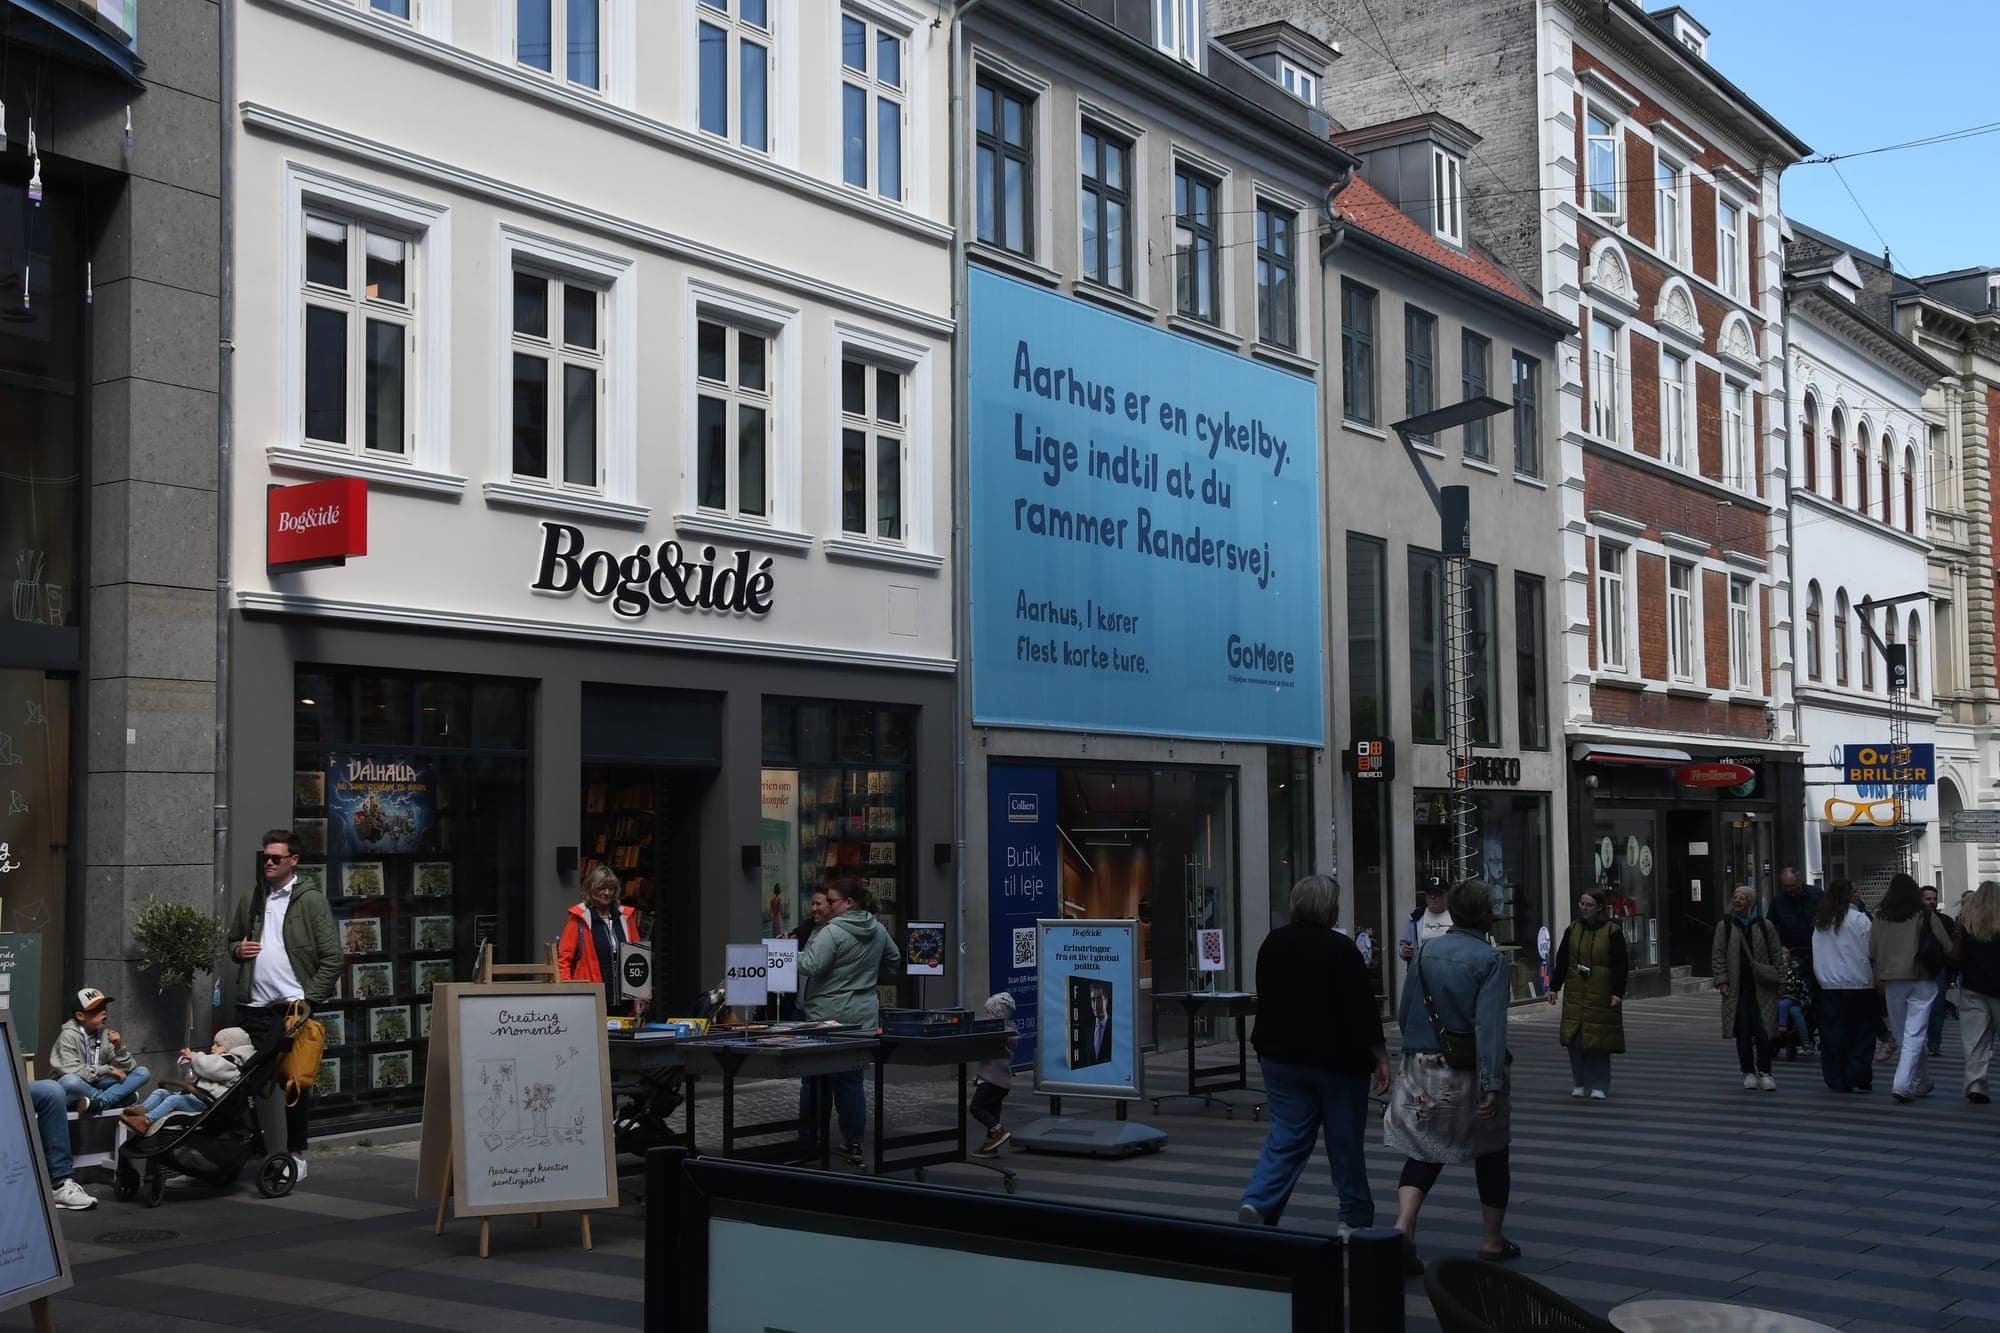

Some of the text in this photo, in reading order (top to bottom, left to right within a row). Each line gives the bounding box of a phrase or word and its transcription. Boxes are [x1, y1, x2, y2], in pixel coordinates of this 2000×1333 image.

[1013, 339, 1290, 476] Aarhus er en cykelby.
[1014, 413, 1231, 509] Lige indtil at du
[278, 505, 340, 533] Bog&idé
[1014, 498, 1275, 590] rammer Randersvej.
[531, 522, 774, 617] Bog&idé
[1016, 589, 1082, 631] Aarhus,
[1097, 606, 1138, 634] kører
[1017, 635, 1149, 674] flest korte ture.
[346, 760, 416, 781] VALHALLA
[1850, 768, 1926, 781] BRILLER
[1011, 800, 1035, 811] Colliers
[1007, 846, 1041, 868] Butik
[1004, 875, 1043, 901] til leje
[1072, 928, 1102, 937] Bog&idé
[1055, 953, 1068, 962] fra
[1093, 953, 1120, 964] global
[1063, 944, 1111, 955] Erindringer
[1074, 963, 1101, 971] politik
[498, 1010, 561, 1026] Creating
